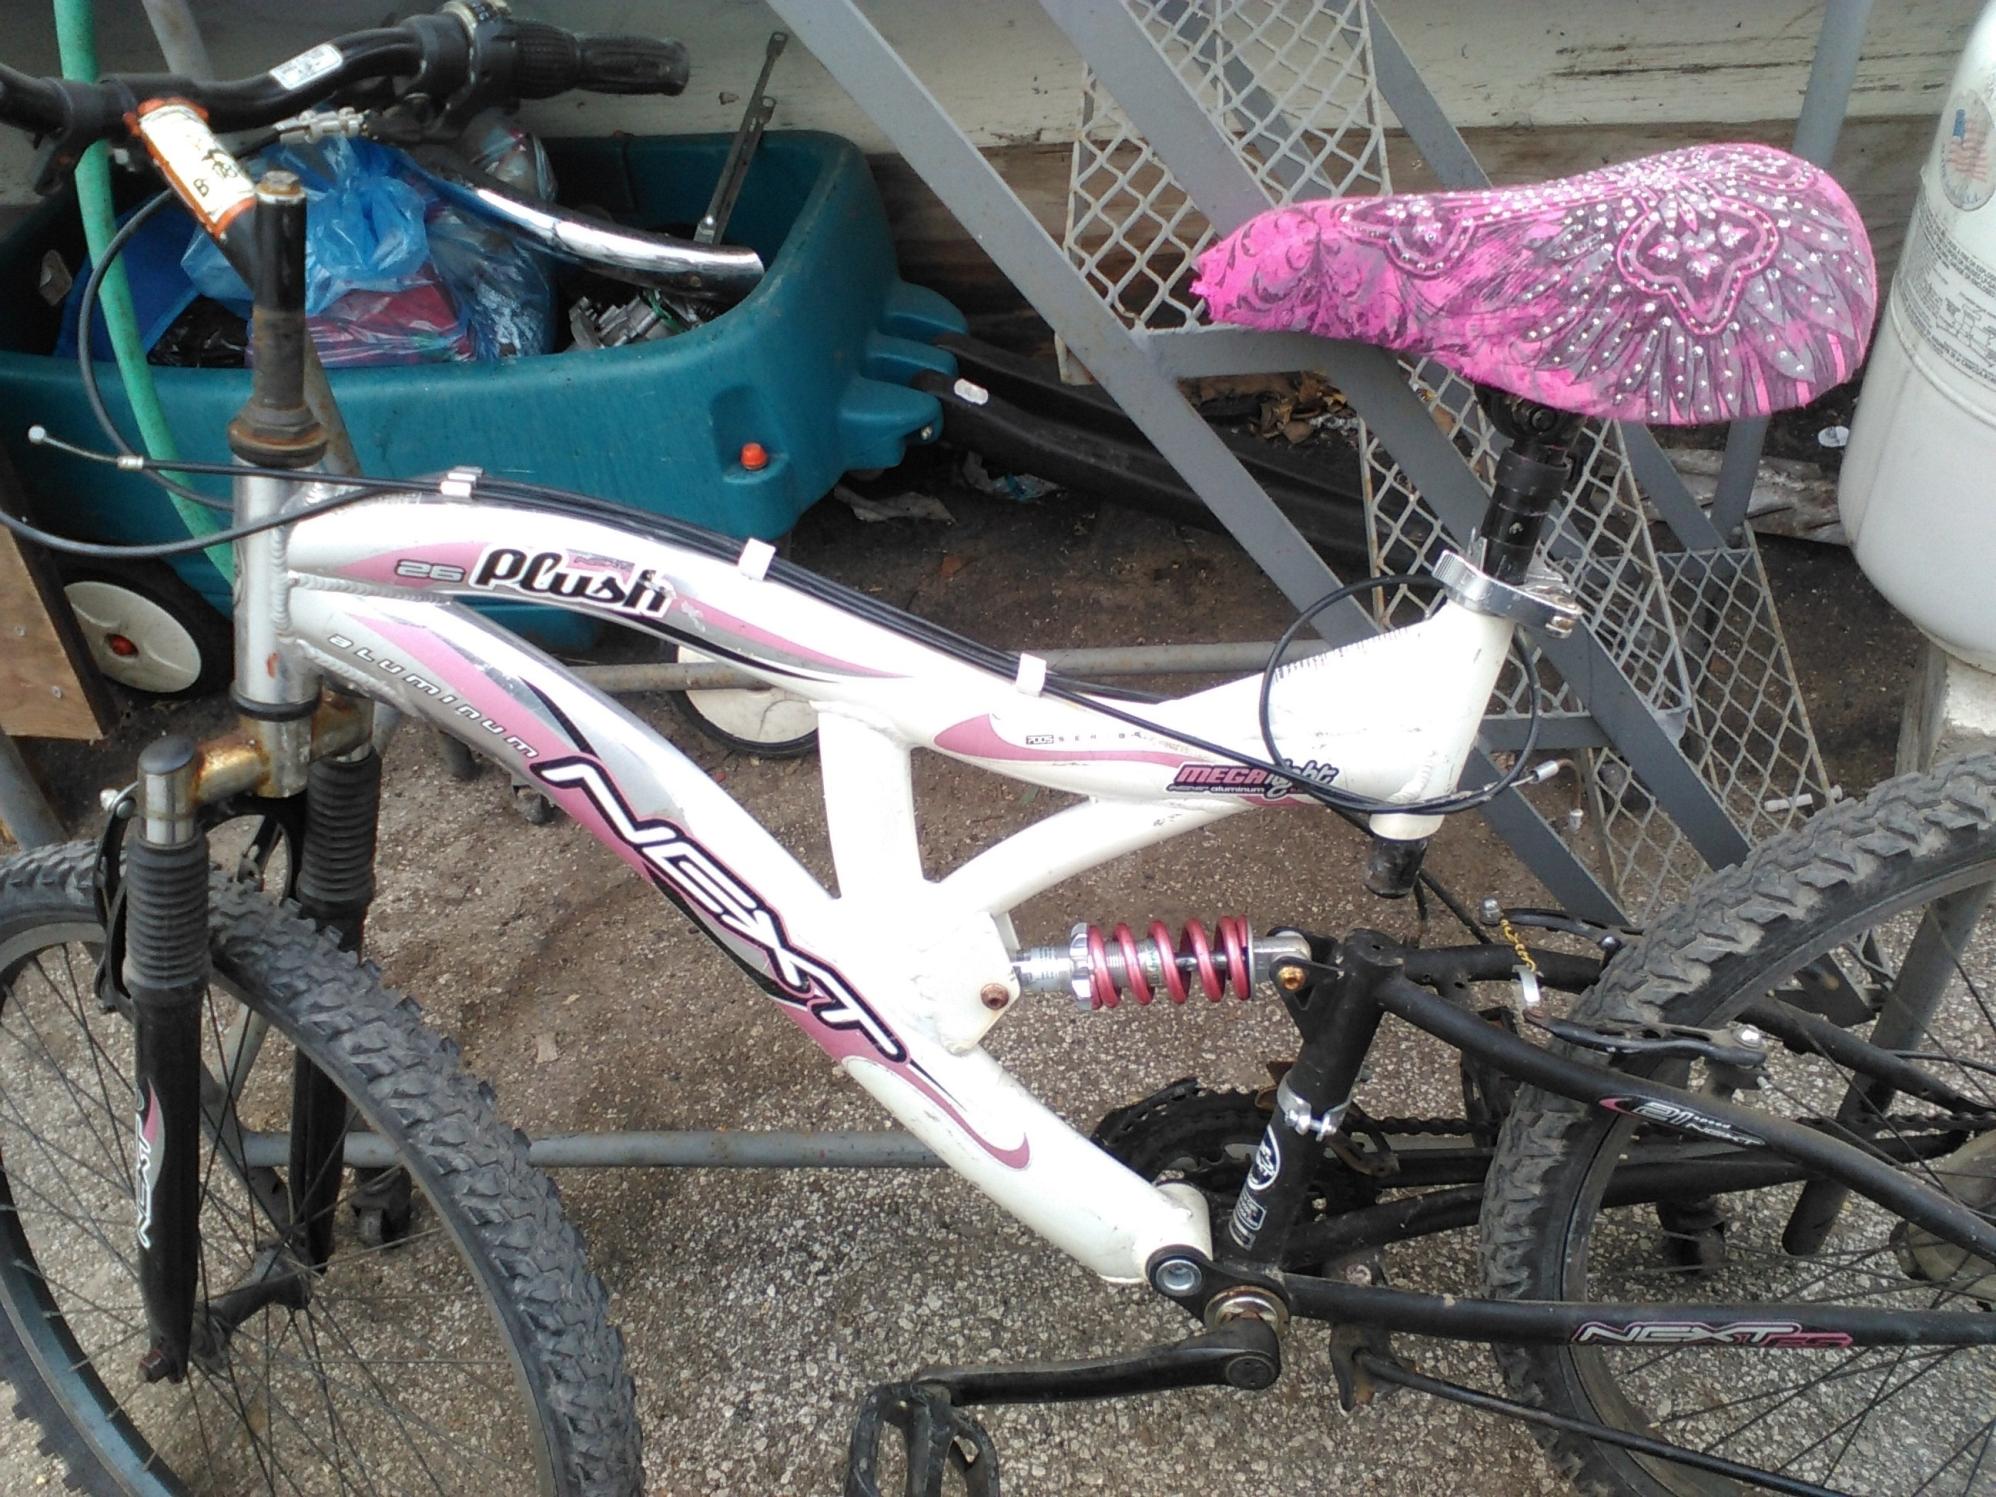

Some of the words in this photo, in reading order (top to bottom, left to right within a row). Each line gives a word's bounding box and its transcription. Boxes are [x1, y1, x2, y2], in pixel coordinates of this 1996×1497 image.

[395, 558, 466, 583] 26
[529, 756, 908, 1063] NEXT
[1631, 1101, 1694, 1125] 21
[1573, 1321, 1801, 1344] NEXT
